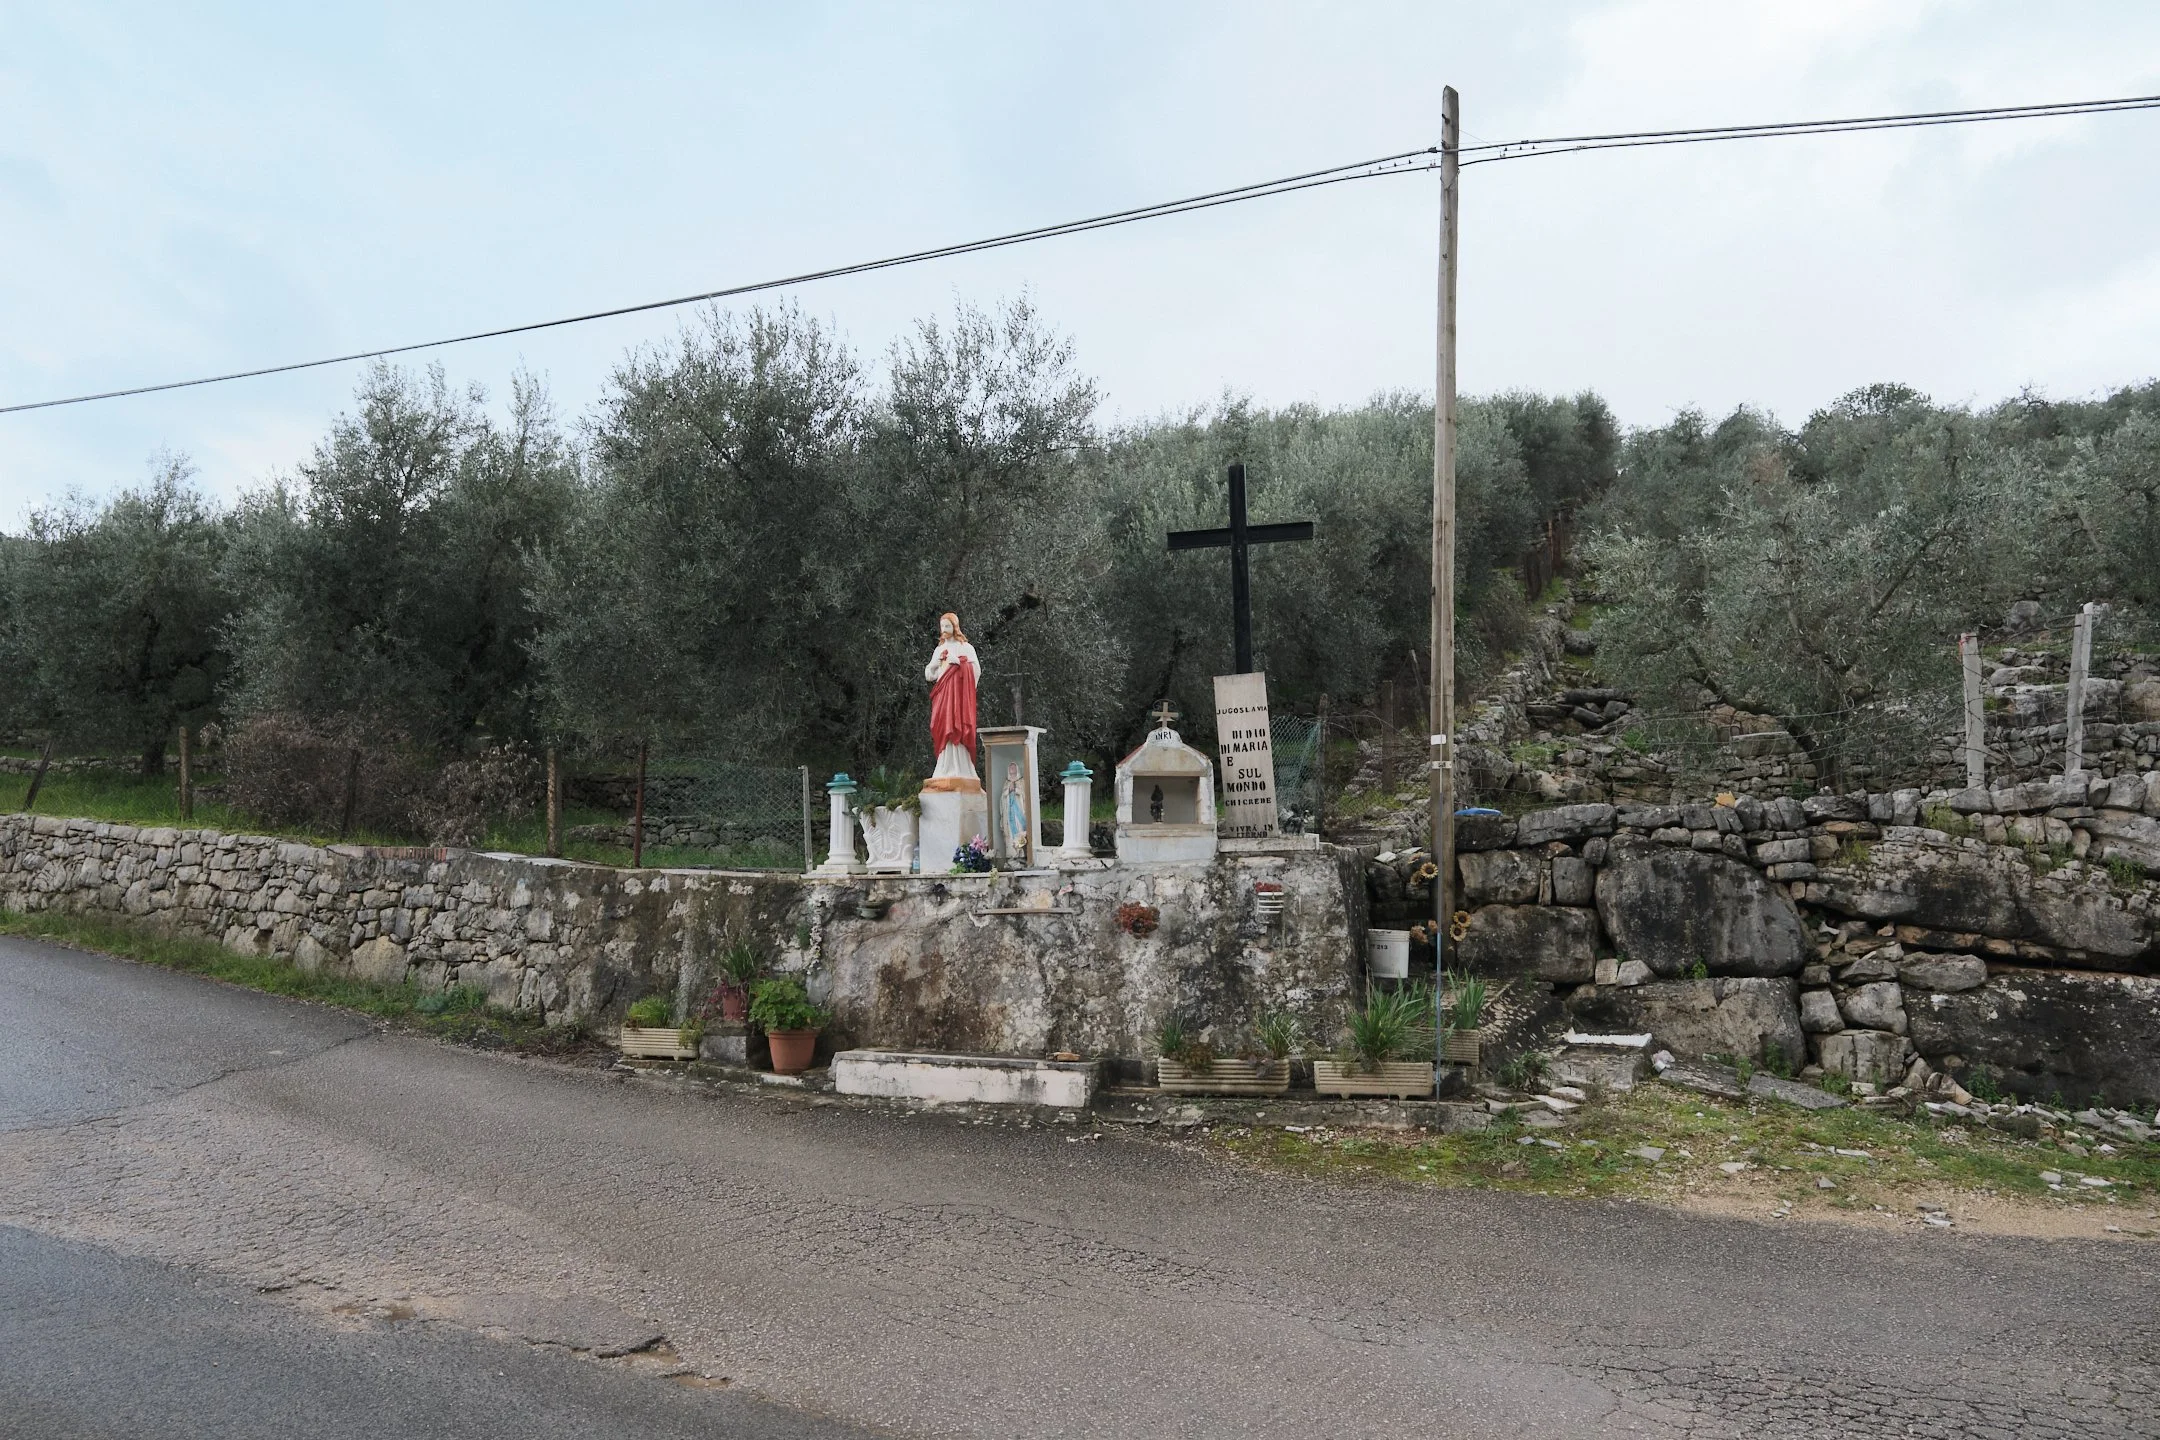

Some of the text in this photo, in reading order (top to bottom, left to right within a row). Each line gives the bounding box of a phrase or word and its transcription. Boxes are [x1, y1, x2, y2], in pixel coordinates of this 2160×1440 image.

[1216, 706, 1268, 715] JUGOSLAVIA
[1155, 731, 1172, 740] INRI
[1246, 728, 1266, 739] DIO
[1220, 740, 1268, 755] DI MARIA
[1226, 756, 1234, 767] E
[1238, 768, 1262, 779] SUL
[1226, 780, 1266, 793] MONDO
